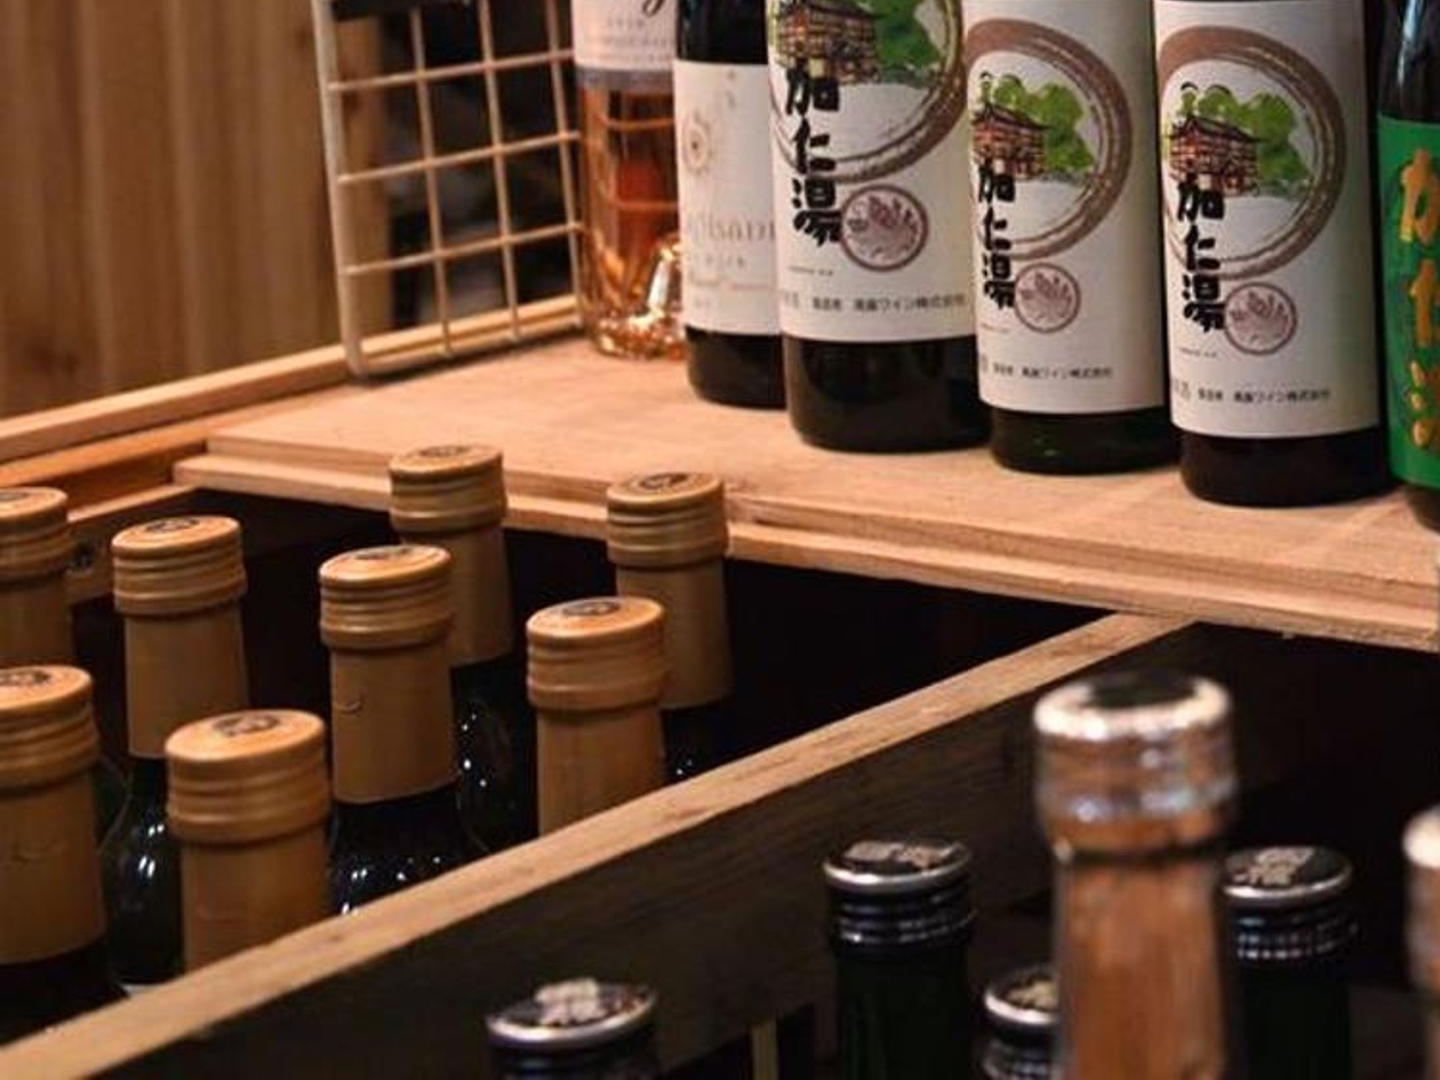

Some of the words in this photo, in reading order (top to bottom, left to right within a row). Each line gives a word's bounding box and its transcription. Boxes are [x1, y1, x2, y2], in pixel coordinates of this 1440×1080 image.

[785, 67, 841, 247] 加仁湯
[978, 163, 1016, 310] 加仁湯
[1176, 178, 1227, 333] 加仁湯
